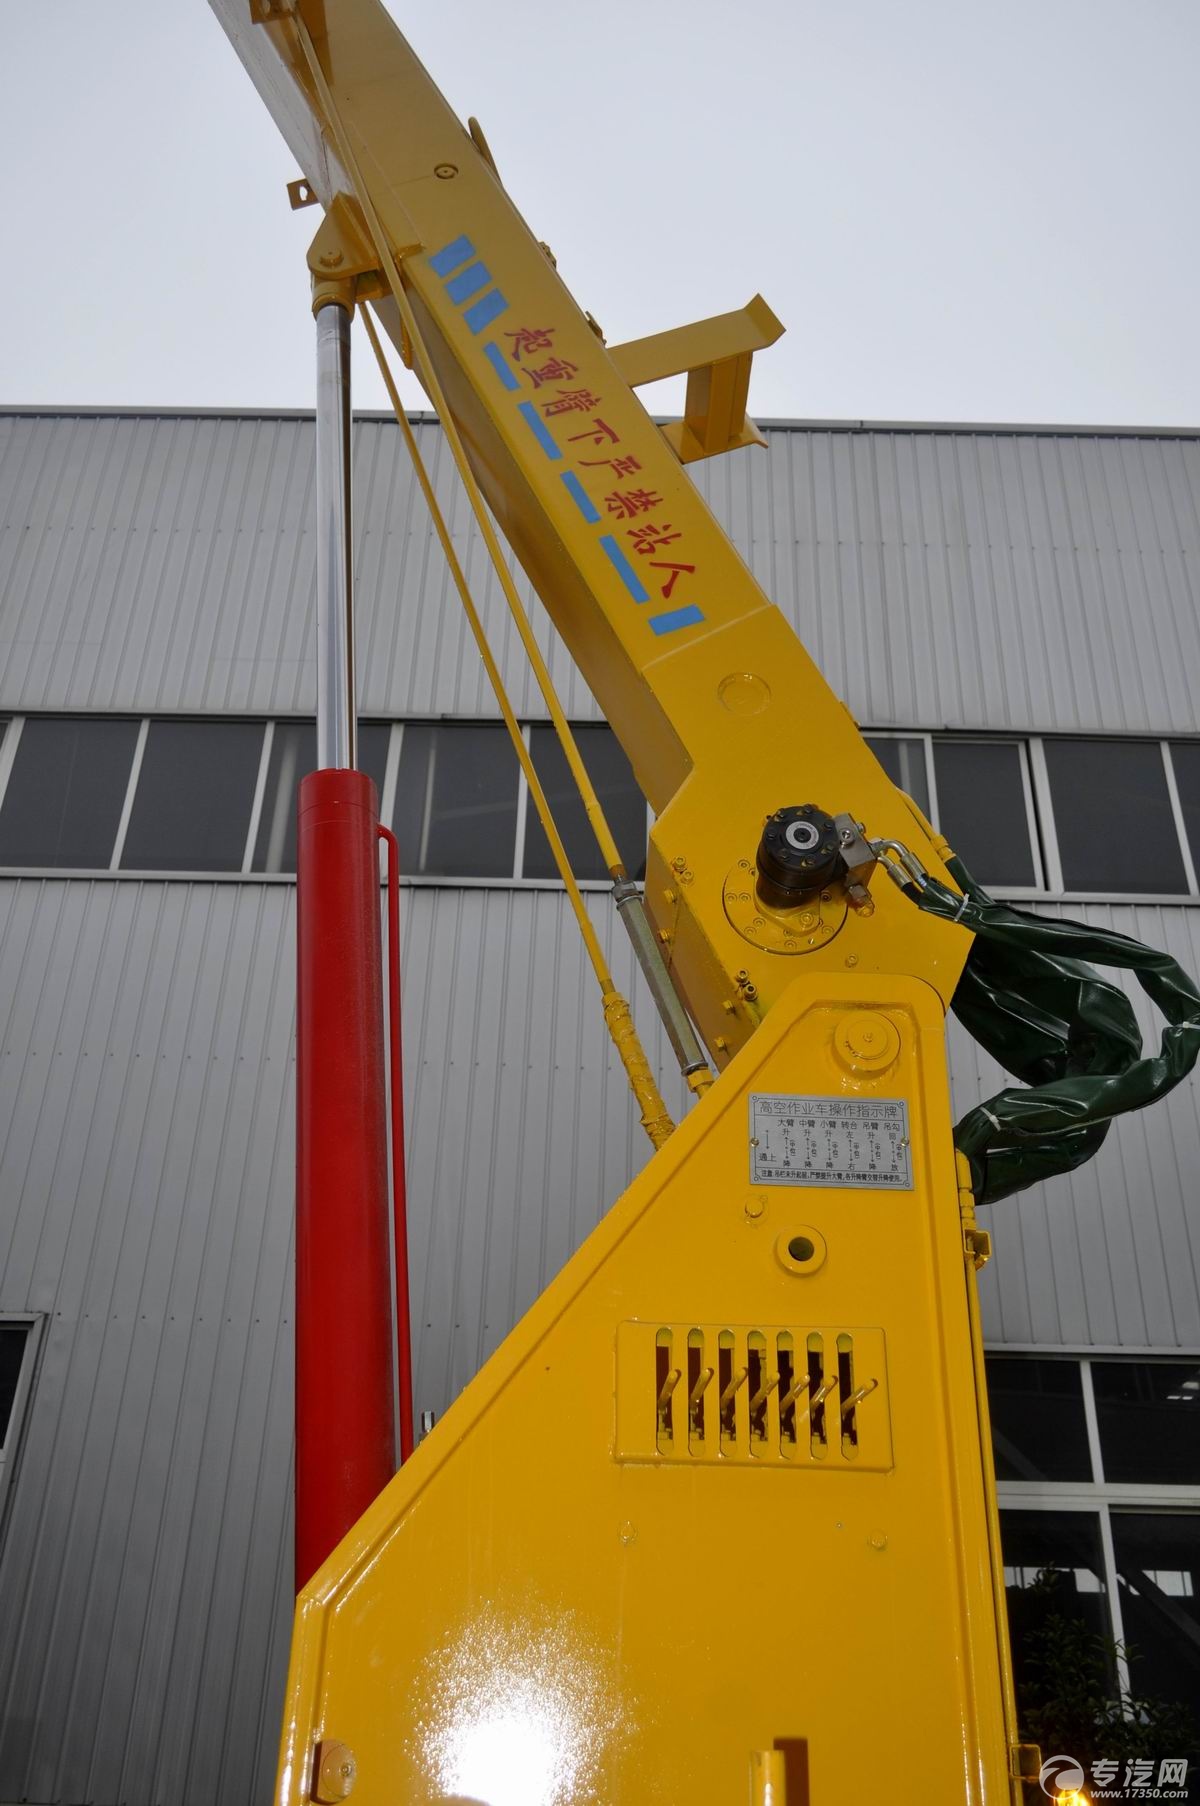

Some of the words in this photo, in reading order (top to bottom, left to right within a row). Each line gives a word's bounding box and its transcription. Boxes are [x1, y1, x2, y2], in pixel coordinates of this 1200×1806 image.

[504, 328, 695, 599] 起重臂下严禁站人
[760, 1101, 897, 1118] 高空作业车操作指示牌
[777, 1118, 795, 1128] 大臂
[799, 1119, 816, 1129] 中臂
[820, 1120, 837, 1130] 小臂
[863, 1122, 879, 1131] 吊臂
